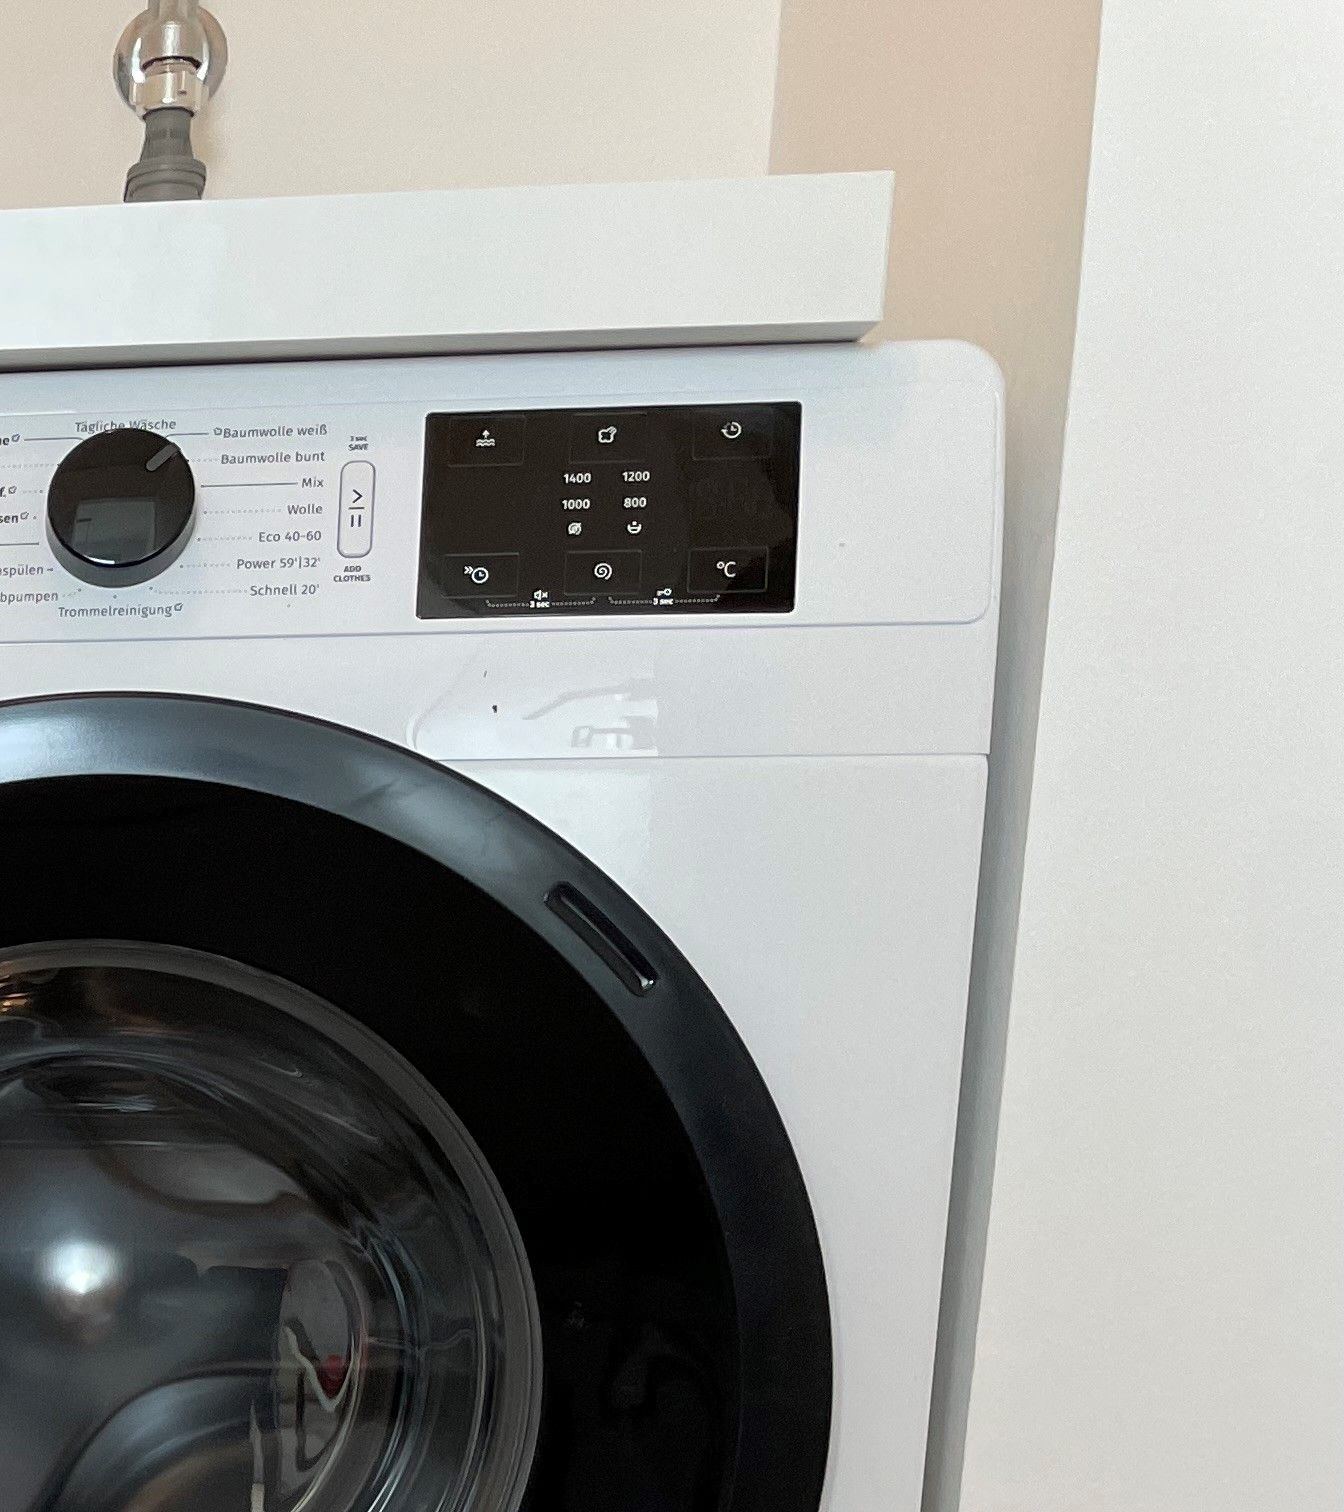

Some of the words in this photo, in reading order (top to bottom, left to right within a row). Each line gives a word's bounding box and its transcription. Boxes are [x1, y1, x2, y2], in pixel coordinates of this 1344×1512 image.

[223, 427, 293, 438] Baumwolle
[297, 424, 327, 436] weiß
[221, 453, 291, 465] Baumwolle
[295, 452, 325, 463] bunt
[301, 478, 324, 488] Mix
[563, 472, 592, 485] 1400
[622, 470, 650, 483] 1200
[287, 504, 323, 515] Wolle
[561, 498, 590, 511] 1000
[623, 496, 647, 508] 800
[258, 532, 281, 543] Eco
[284, 531, 322, 542] 40-60
[236, 559, 276, 570] Power
[249, 585, 298, 597] Schnell
[58, 606, 172, 619] Trommelreinigung
